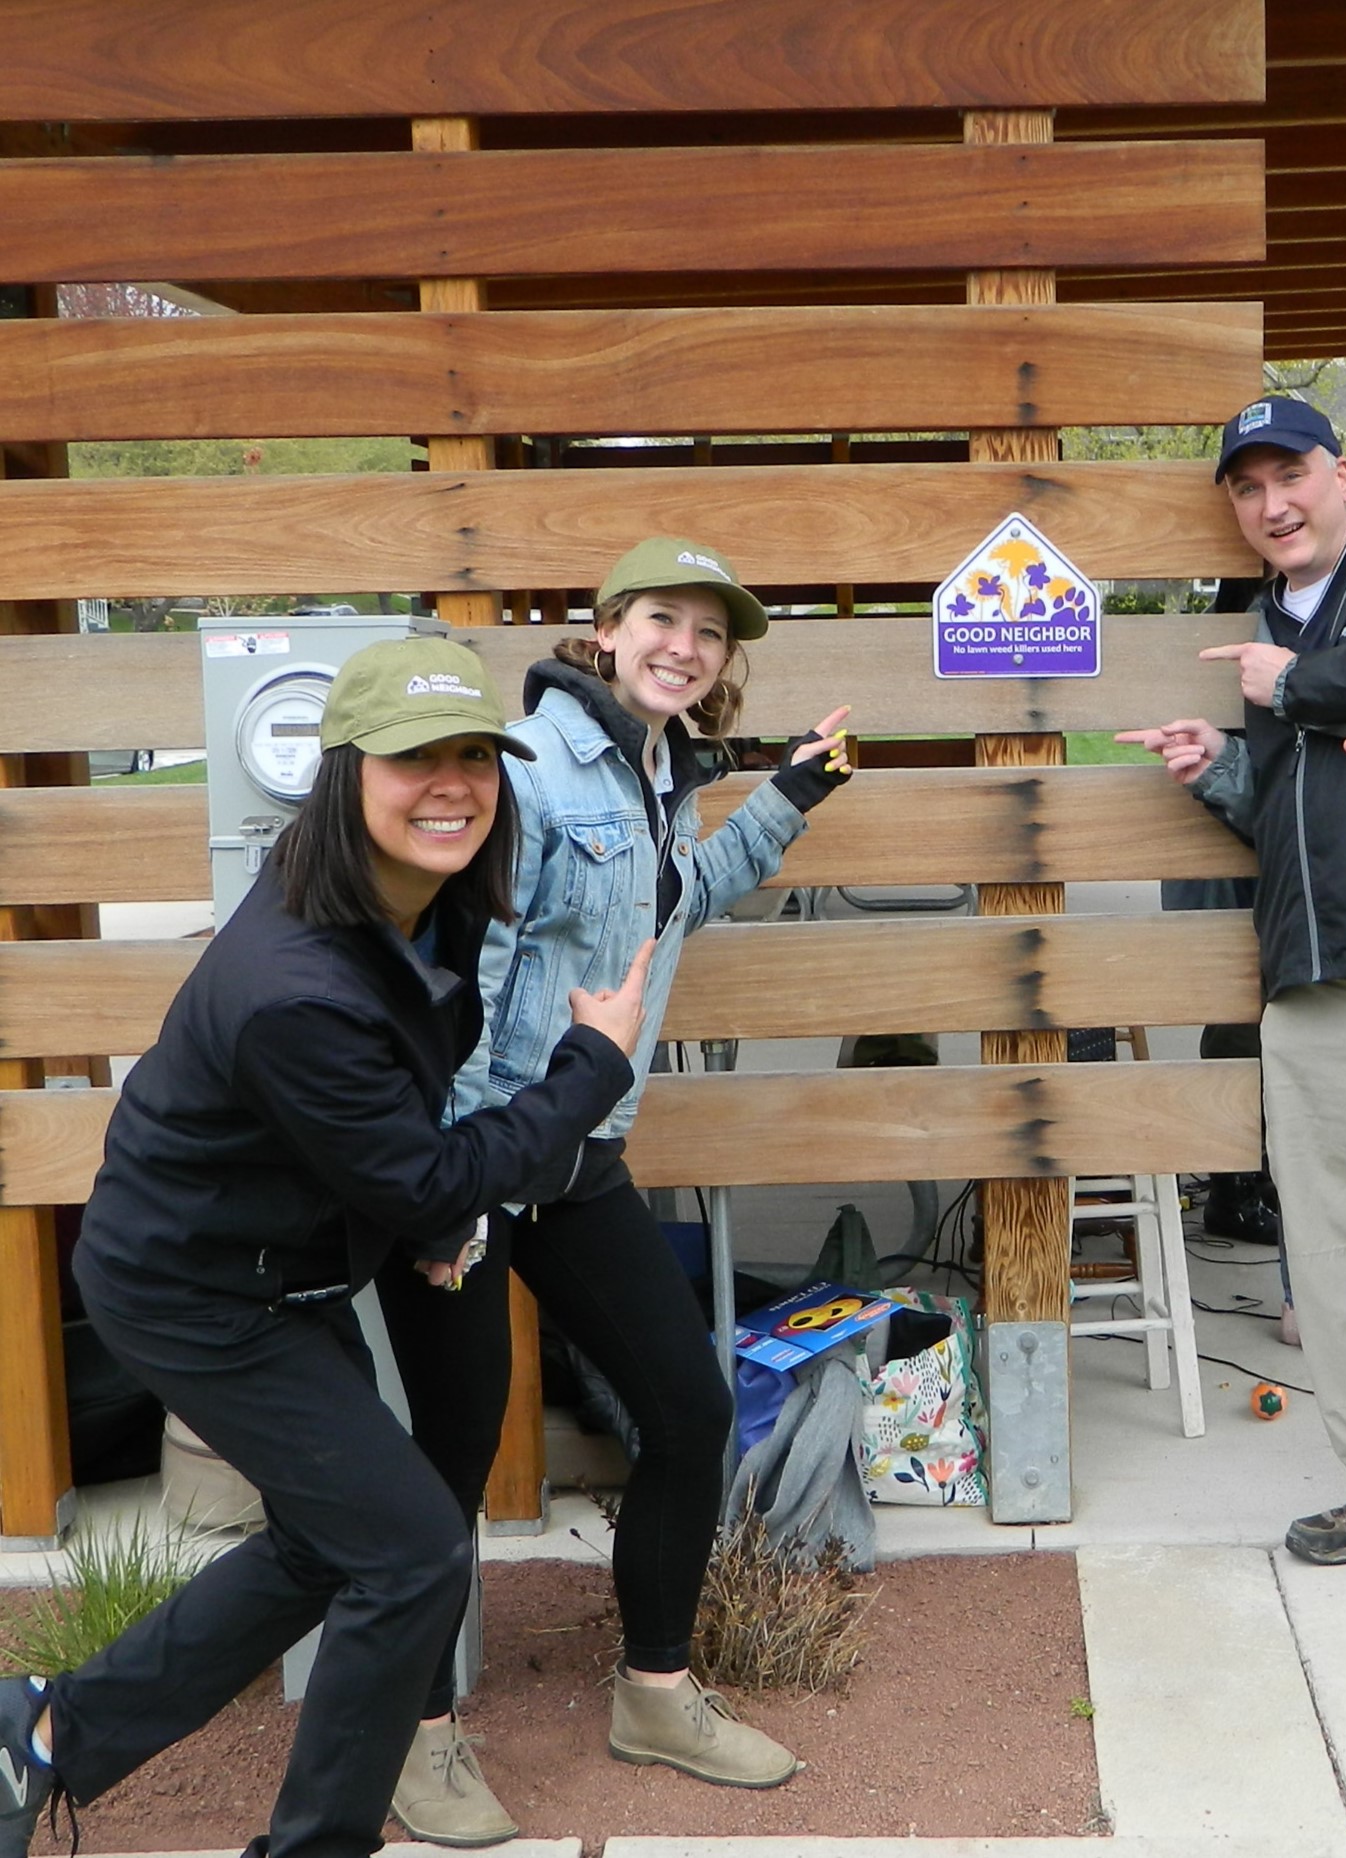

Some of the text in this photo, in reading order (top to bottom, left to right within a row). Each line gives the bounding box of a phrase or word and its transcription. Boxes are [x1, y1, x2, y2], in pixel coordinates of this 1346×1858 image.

[943, 626, 1092, 643] GOOD NEIGHBOR
[953, 643, 1082, 654] No lawn weed killers used here
[429, 673, 460, 684] GOOD
